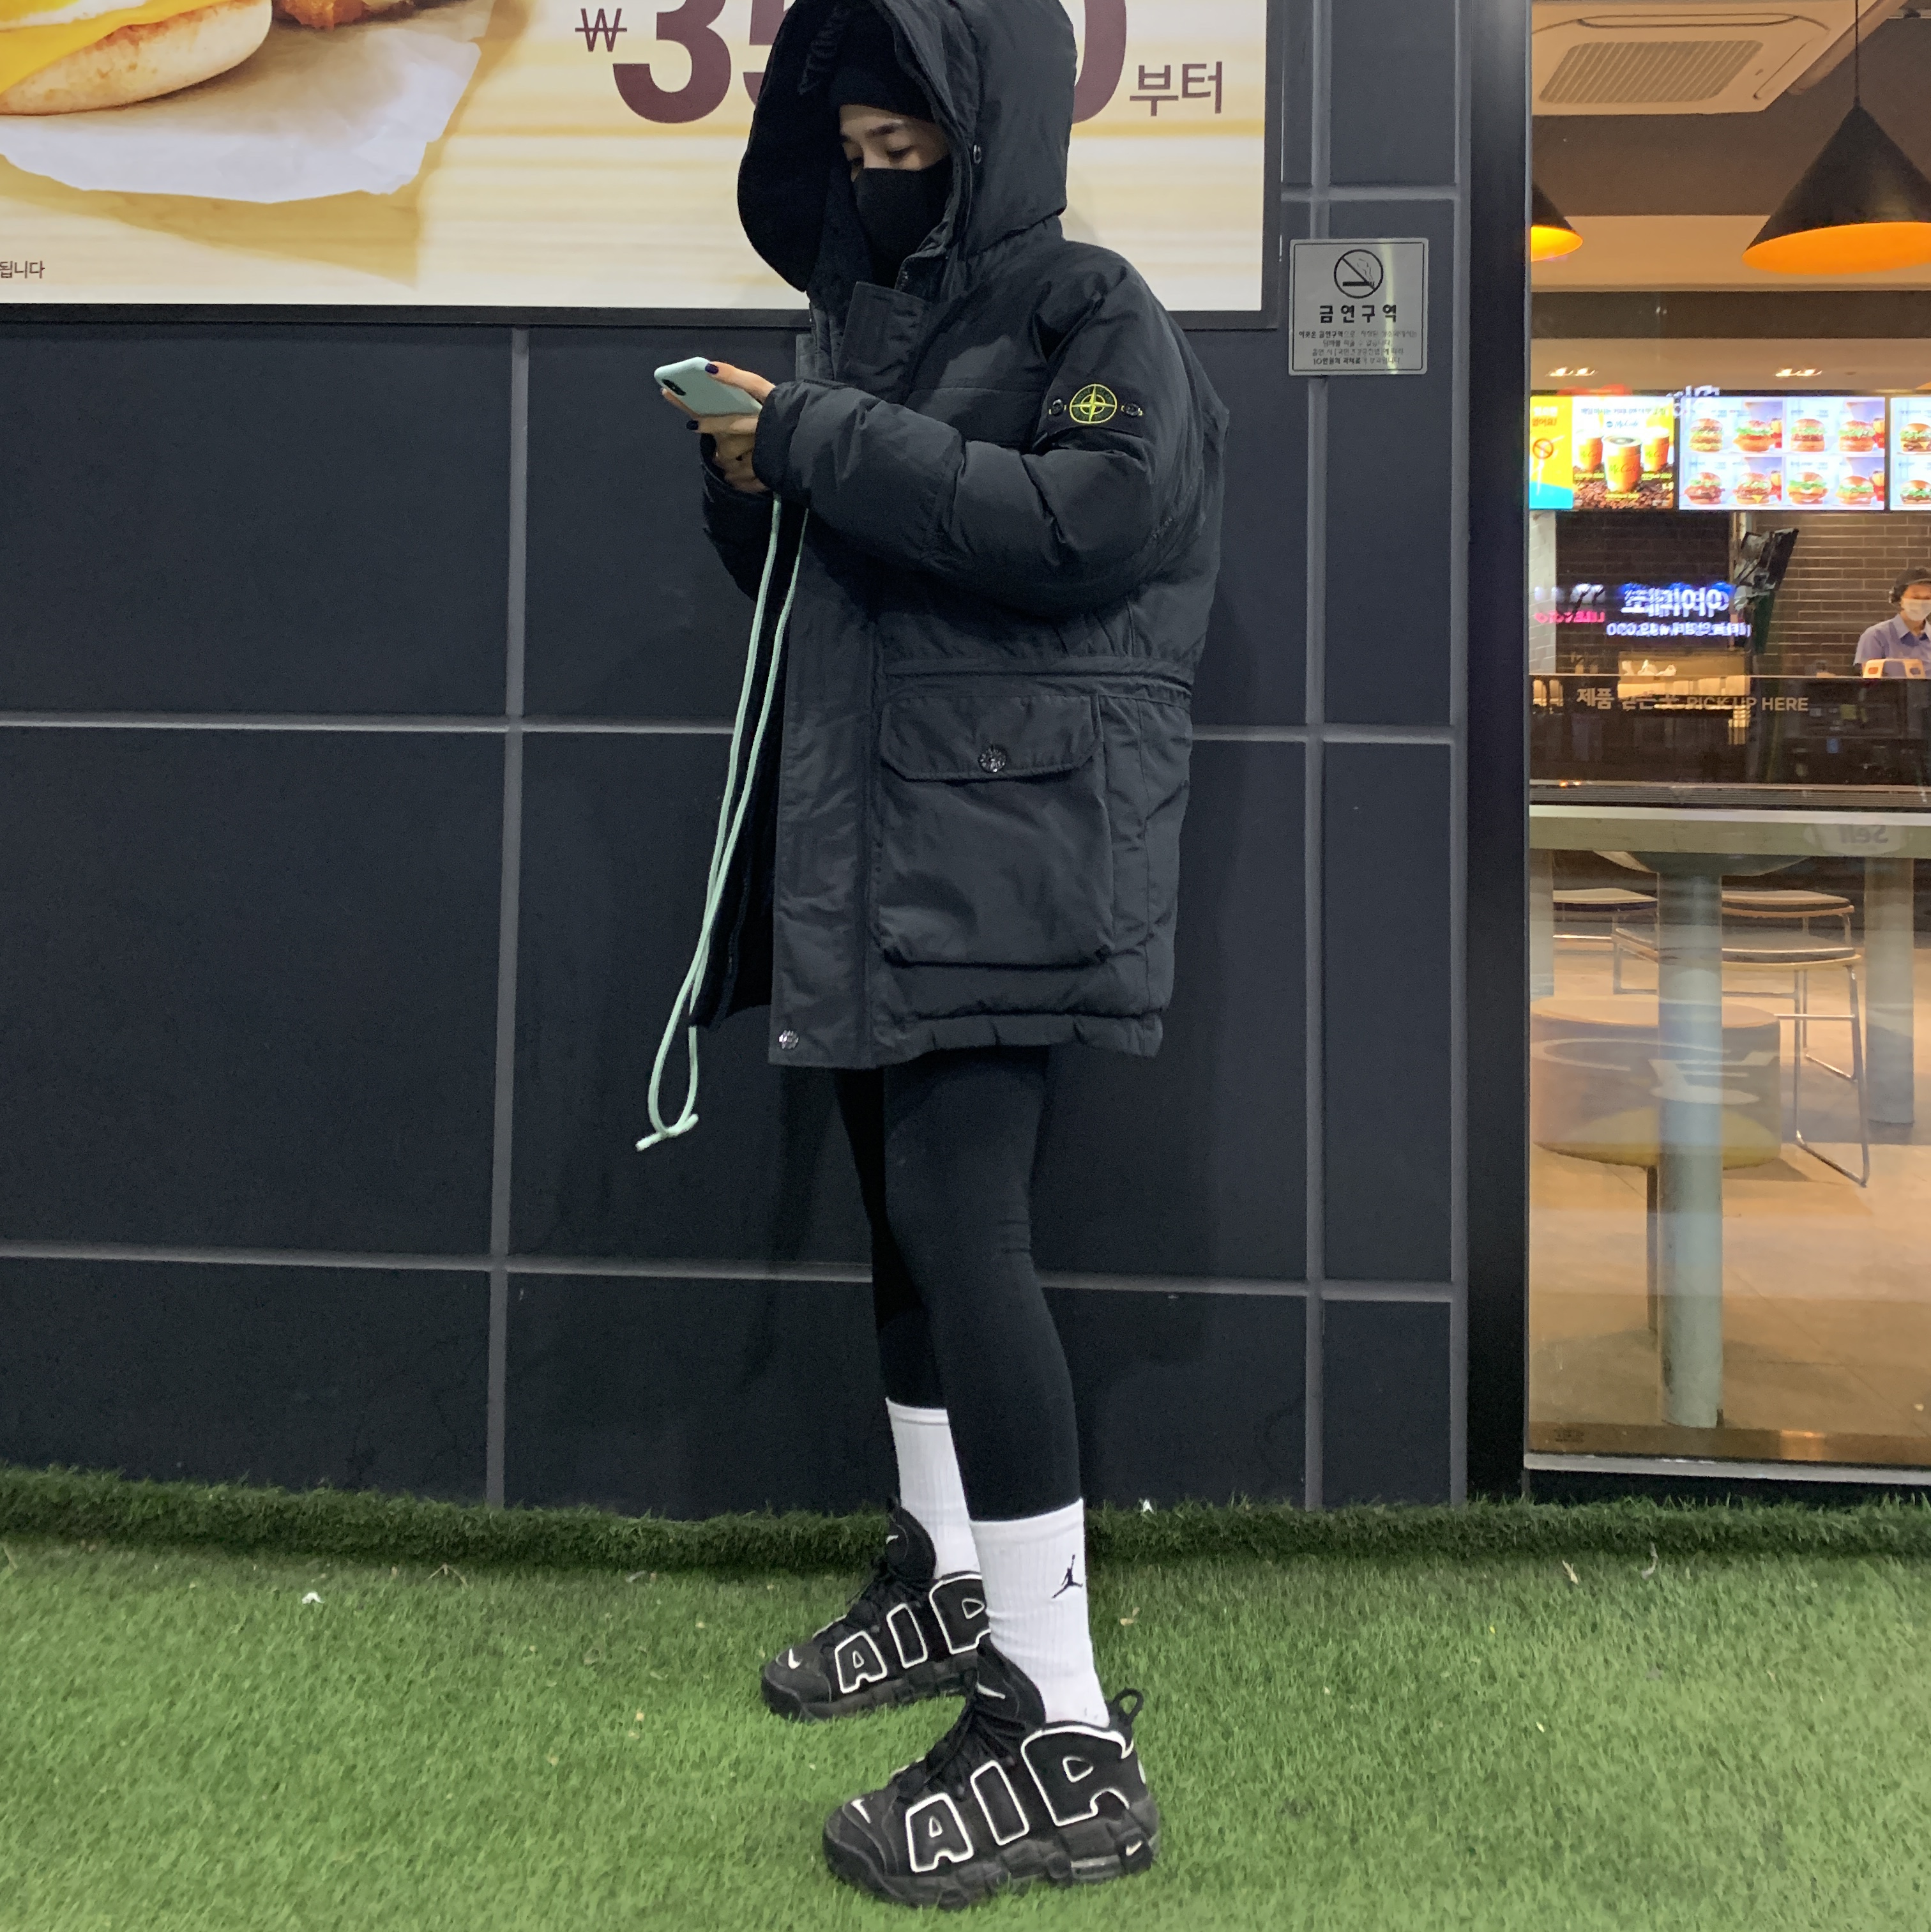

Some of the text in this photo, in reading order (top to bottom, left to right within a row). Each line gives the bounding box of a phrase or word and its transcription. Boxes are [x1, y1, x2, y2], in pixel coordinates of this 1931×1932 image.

[1130, 61, 1223, 116] 부터
[1319, 304, 1397, 324] 금연구역
[1576, 687, 1615, 710] 제품
[1761, 696, 1809, 711] HERE
[834, 1571, 992, 1694] AIR
[905, 1722, 1134, 1873] AIR
